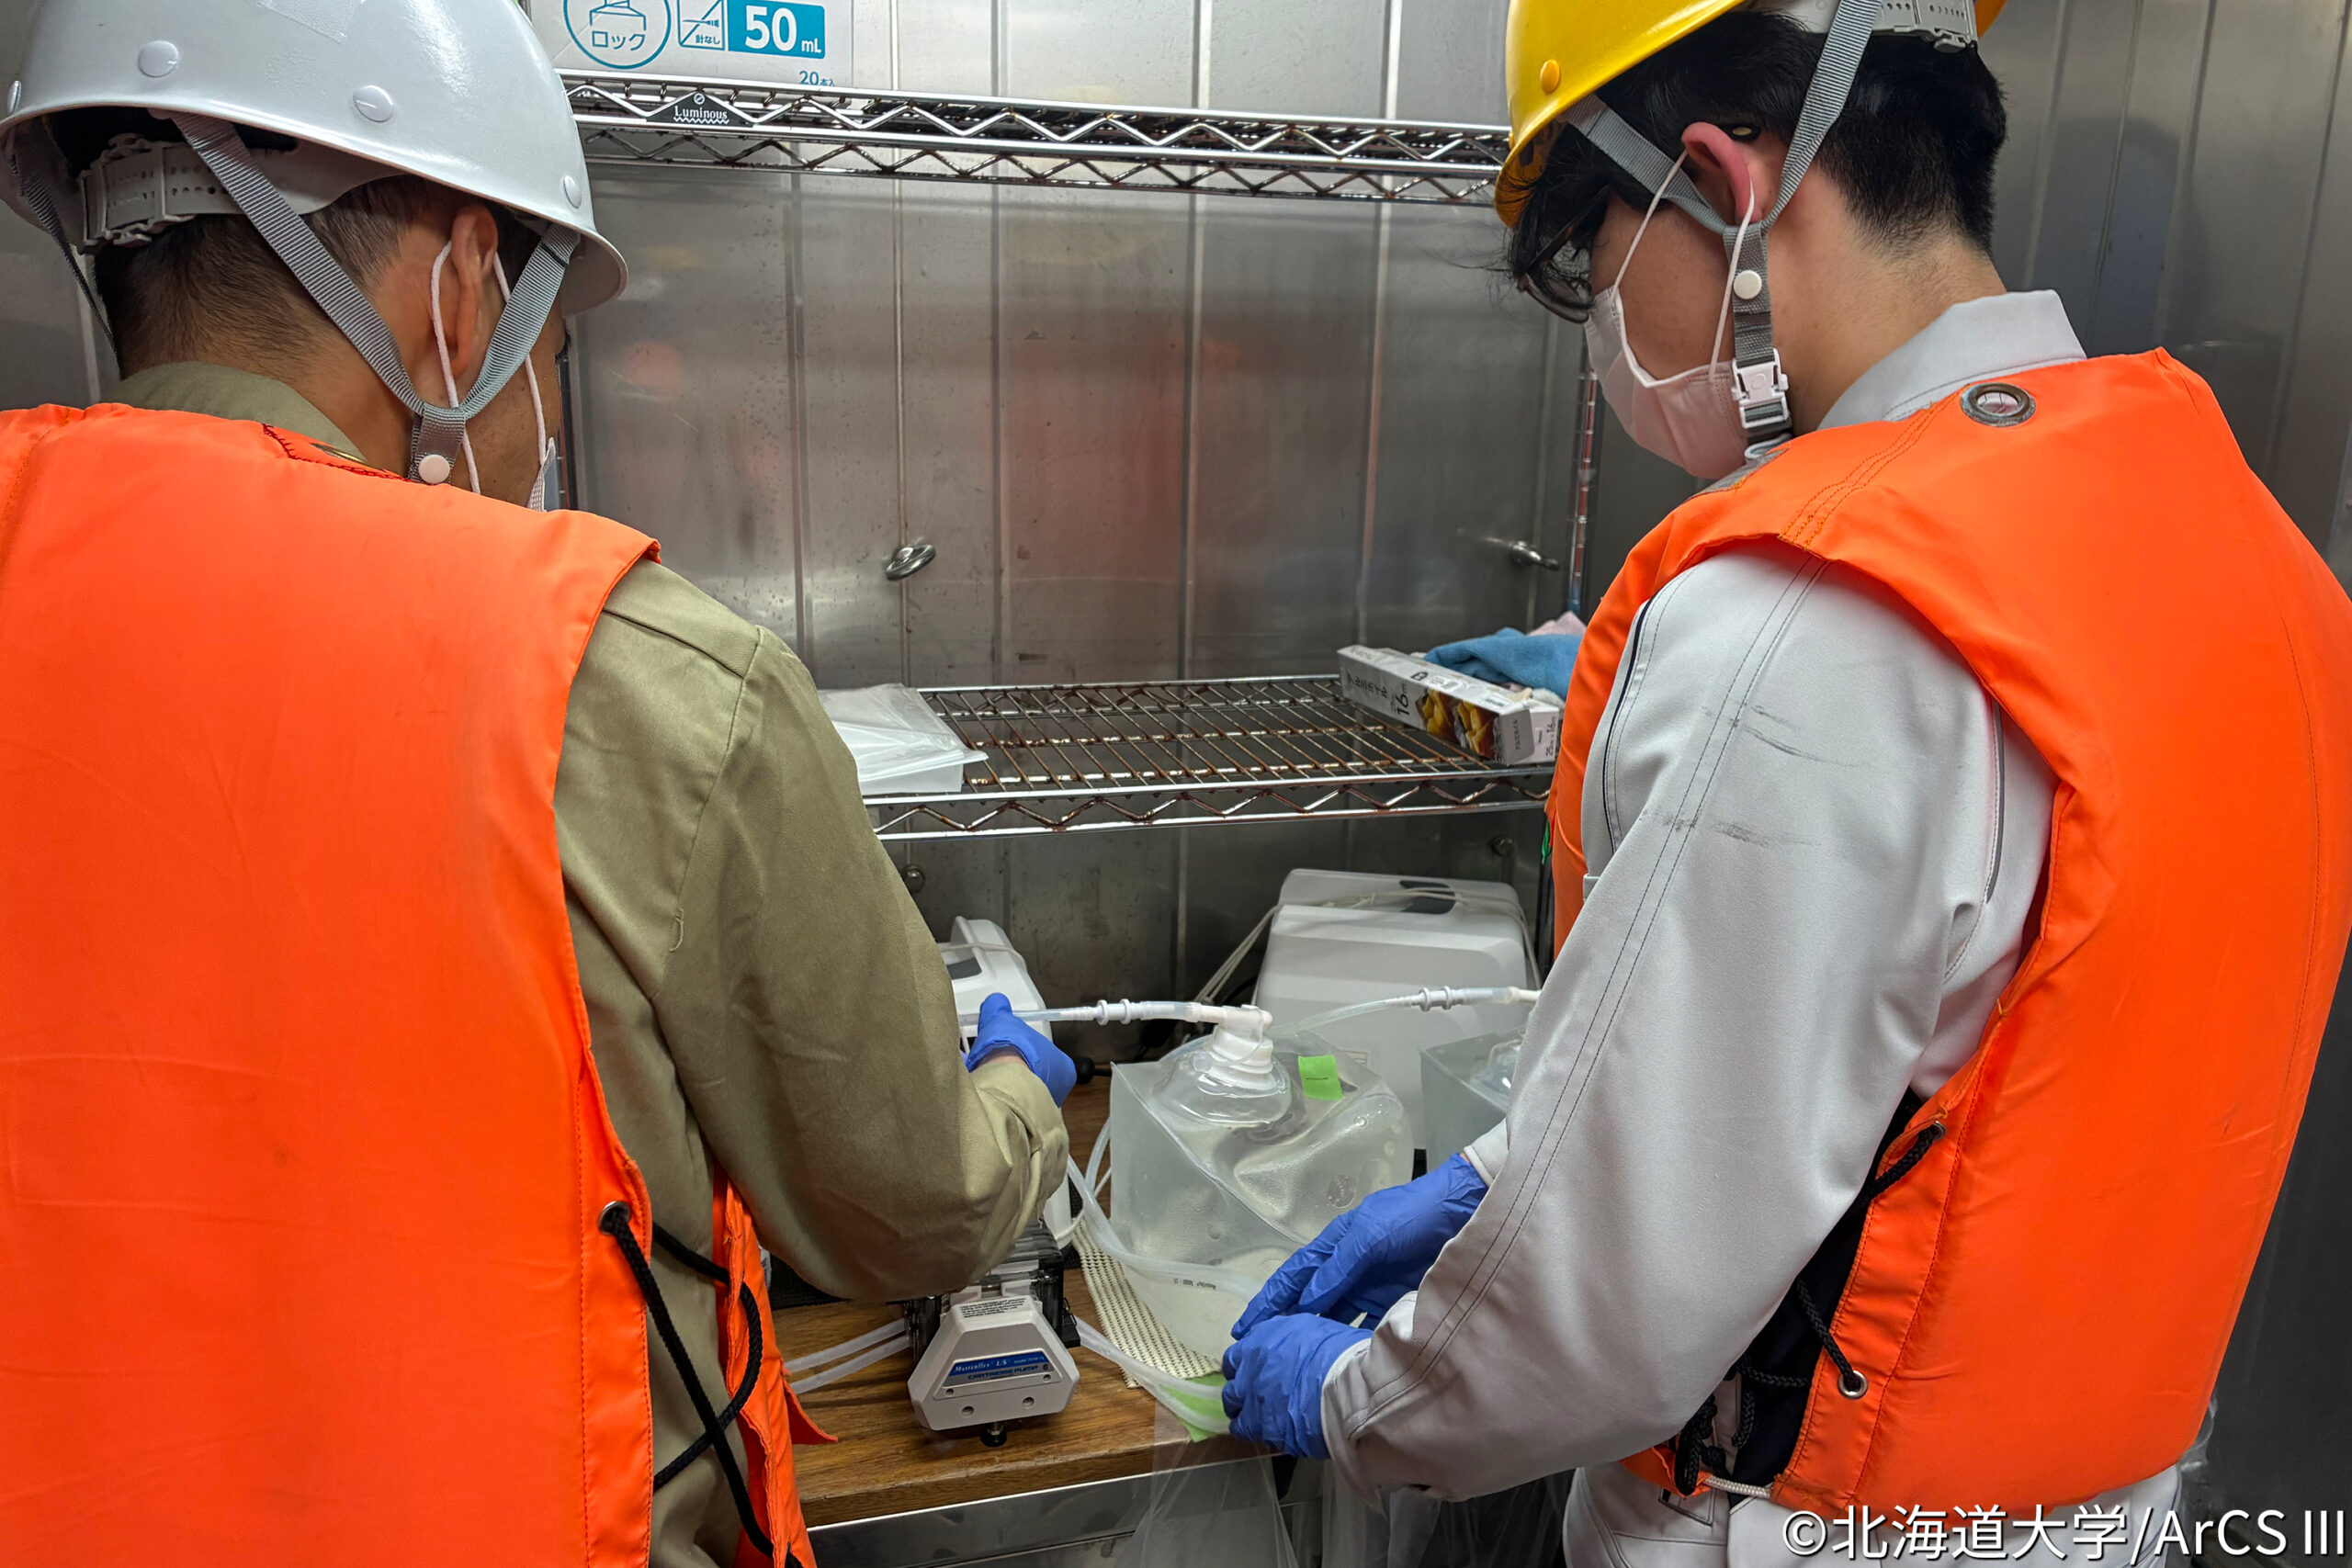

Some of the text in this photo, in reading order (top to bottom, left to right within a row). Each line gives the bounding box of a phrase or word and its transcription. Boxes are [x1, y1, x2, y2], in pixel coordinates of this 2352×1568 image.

[592, 30, 646, 51] ロック
[695, 35, 721, 46] 針なし
[673, 105, 728, 120] Luminous
